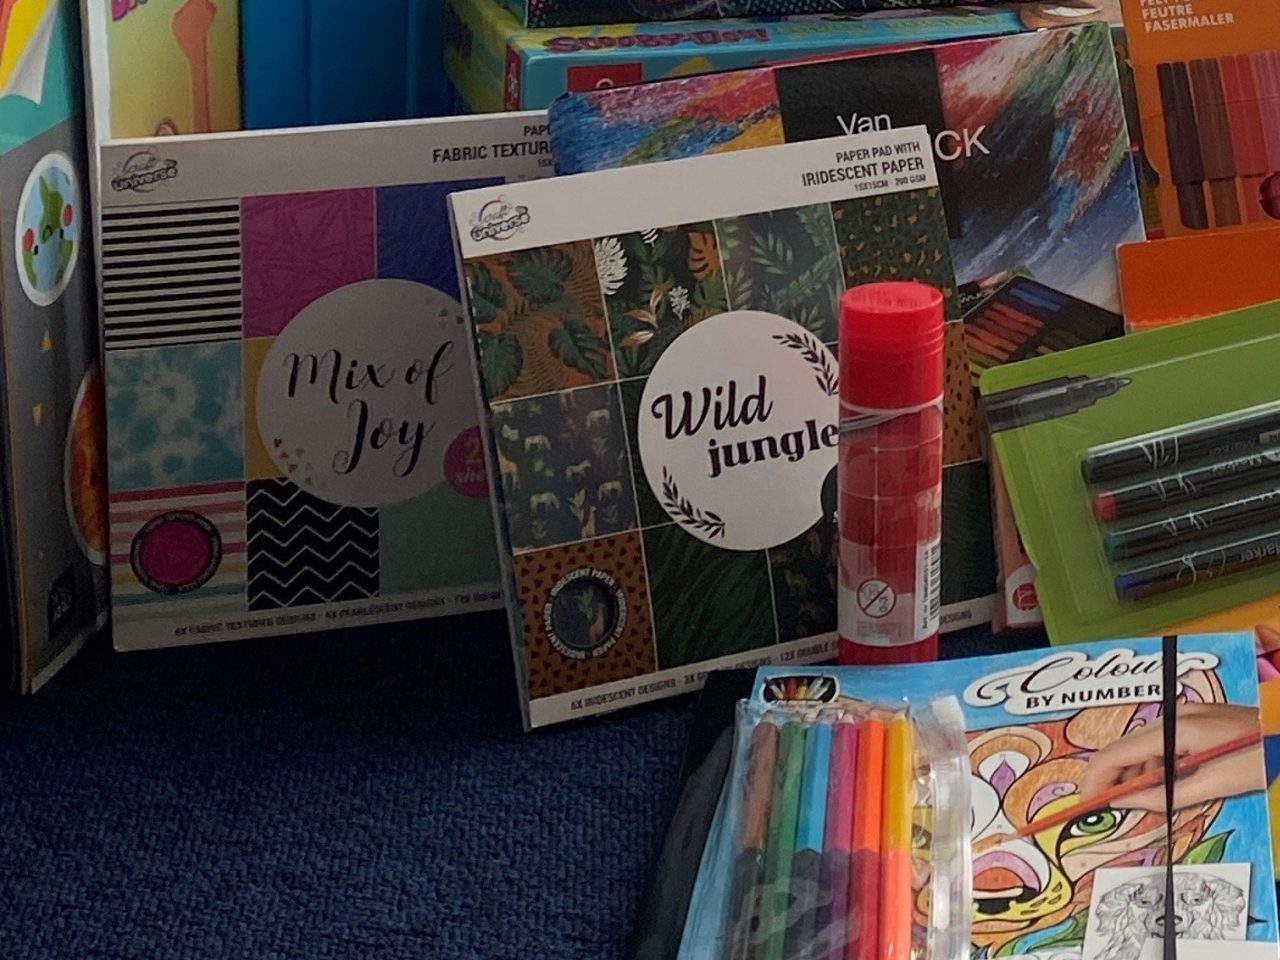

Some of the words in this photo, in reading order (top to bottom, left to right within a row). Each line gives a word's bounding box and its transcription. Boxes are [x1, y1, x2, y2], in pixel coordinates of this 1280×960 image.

[1142, 3, 1194, 19] FEUTRE
[1144, 13, 1235, 32] FASERMALER
[523, 125, 550, 137] PAP
[432, 145, 488, 164] FABRIC
[492, 141, 553, 159] TEXTUR
[835, 147, 871, 164] PAPER
[872, 144, 893, 161] PAD
[894, 141, 921, 155] WITH
[802, 163, 880, 187] IRIDESCENT
[882, 157, 925, 175] PAPER
[283, 349, 396, 404] Mix
[406, 340, 455, 405] of
[651, 375, 774, 439] Wild
[332, 399, 436, 478] Joy
[706, 419, 839, 479] jungle
[1021, 653, 1176, 693] Colou
[1026, 694, 1055, 710] BY
[1061, 683, 1162, 705] NUMBER
